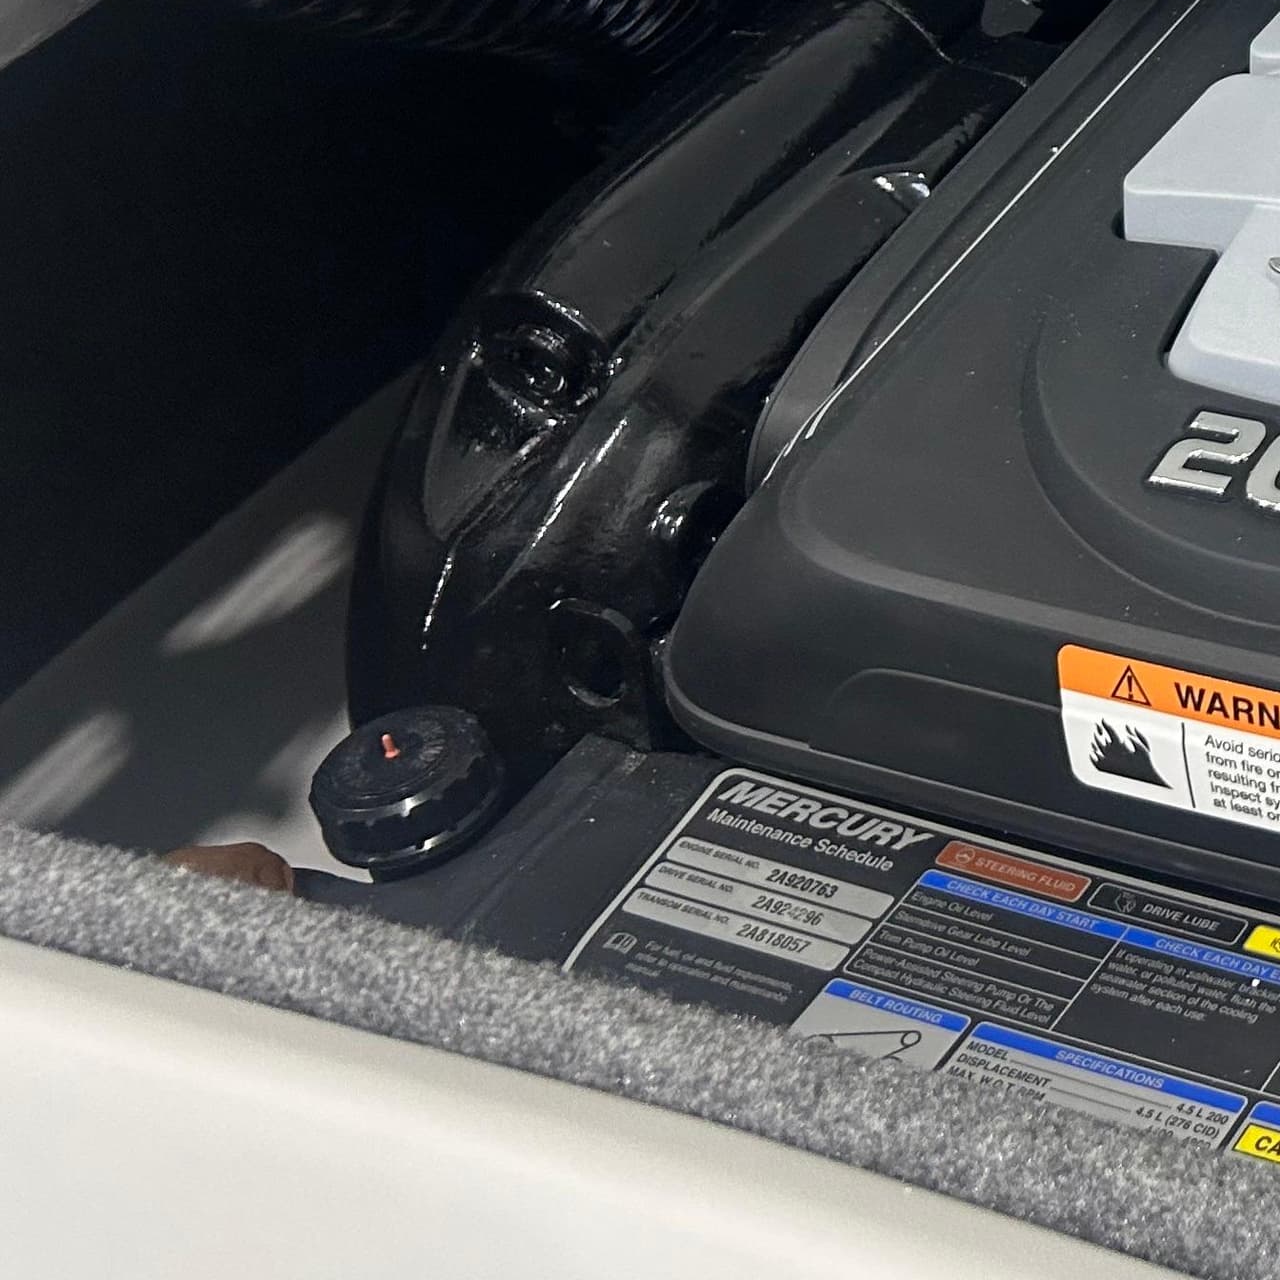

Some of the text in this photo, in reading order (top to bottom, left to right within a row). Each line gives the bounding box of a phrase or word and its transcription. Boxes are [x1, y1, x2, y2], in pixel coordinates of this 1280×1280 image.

[1204, 734, 1243, 754] Avoid
[1205, 751, 1237, 769] from
[1240, 759, 1262, 775] fire
[1266, 768, 1280, 778] or
[1207, 769, 1266, 793] resulting
[1210, 781, 1261, 803] Inspect
[1213, 798, 1226, 808] at
[1229, 799, 1262, 817] least
[717, 780, 934, 851] MERCURY
[706, 808, 892, 870] Maintenance Schedule
[678, 840, 838, 898] ENGINE SERIAL NO. 2A920763
[975, 857, 1075, 891] STEERING FLUID
[658, 865, 823, 925] DRIVE SERIAL NO. 2A924296
[910, 891, 993, 920] Engine Oil Level
[947, 880, 1098, 928] CHECK EACH DAY START
[638, 891, 810, 952] TRANSOM SERIAL NO. 2A818057
[1142, 903, 1219, 930] DRIVE LUBE
[879, 929, 980, 966] Trim Pump Oil Level
[1155, 938, 1199, 957] CHECK
[1202, 951, 1240, 967] EACH
[1240, 961, 1269, 975] DAY
[848, 990, 943, 1025] BELT ROUTING
[1090, 983, 1205, 1020] system after each use.
[966, 1040, 1229, 1125] MODEL 4.5 L 200
[1056, 1050, 1163, 1088] SPECIFICATIONS
[956, 1053, 1050, 1086] DISPLACEMENT
[1135, 1106, 1154, 1118] 4.5
[1154, 1111, 1162, 1122] L
[1164, 1114, 1192, 1129] (276
[1192, 1122, 1219, 1139] CID)
